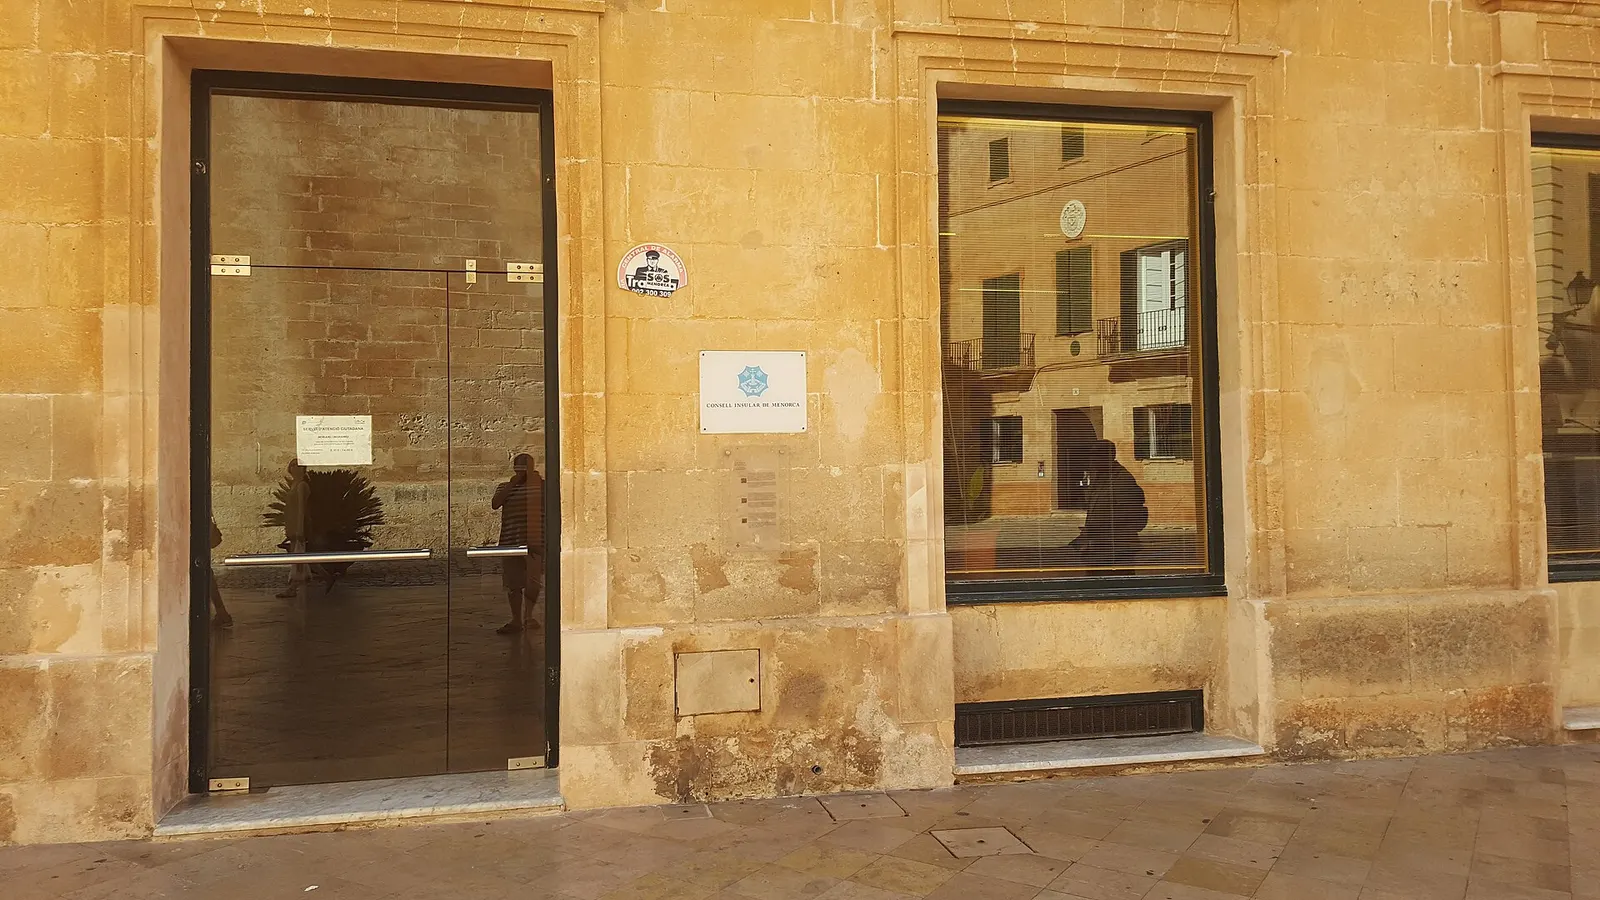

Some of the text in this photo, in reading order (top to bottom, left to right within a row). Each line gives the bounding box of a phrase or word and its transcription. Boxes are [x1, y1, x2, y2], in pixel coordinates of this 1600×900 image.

[622, 246, 650, 268] CENTRAL
[662, 248, 684, 273] ALARMA
[647, 273, 670, 283] SOS
